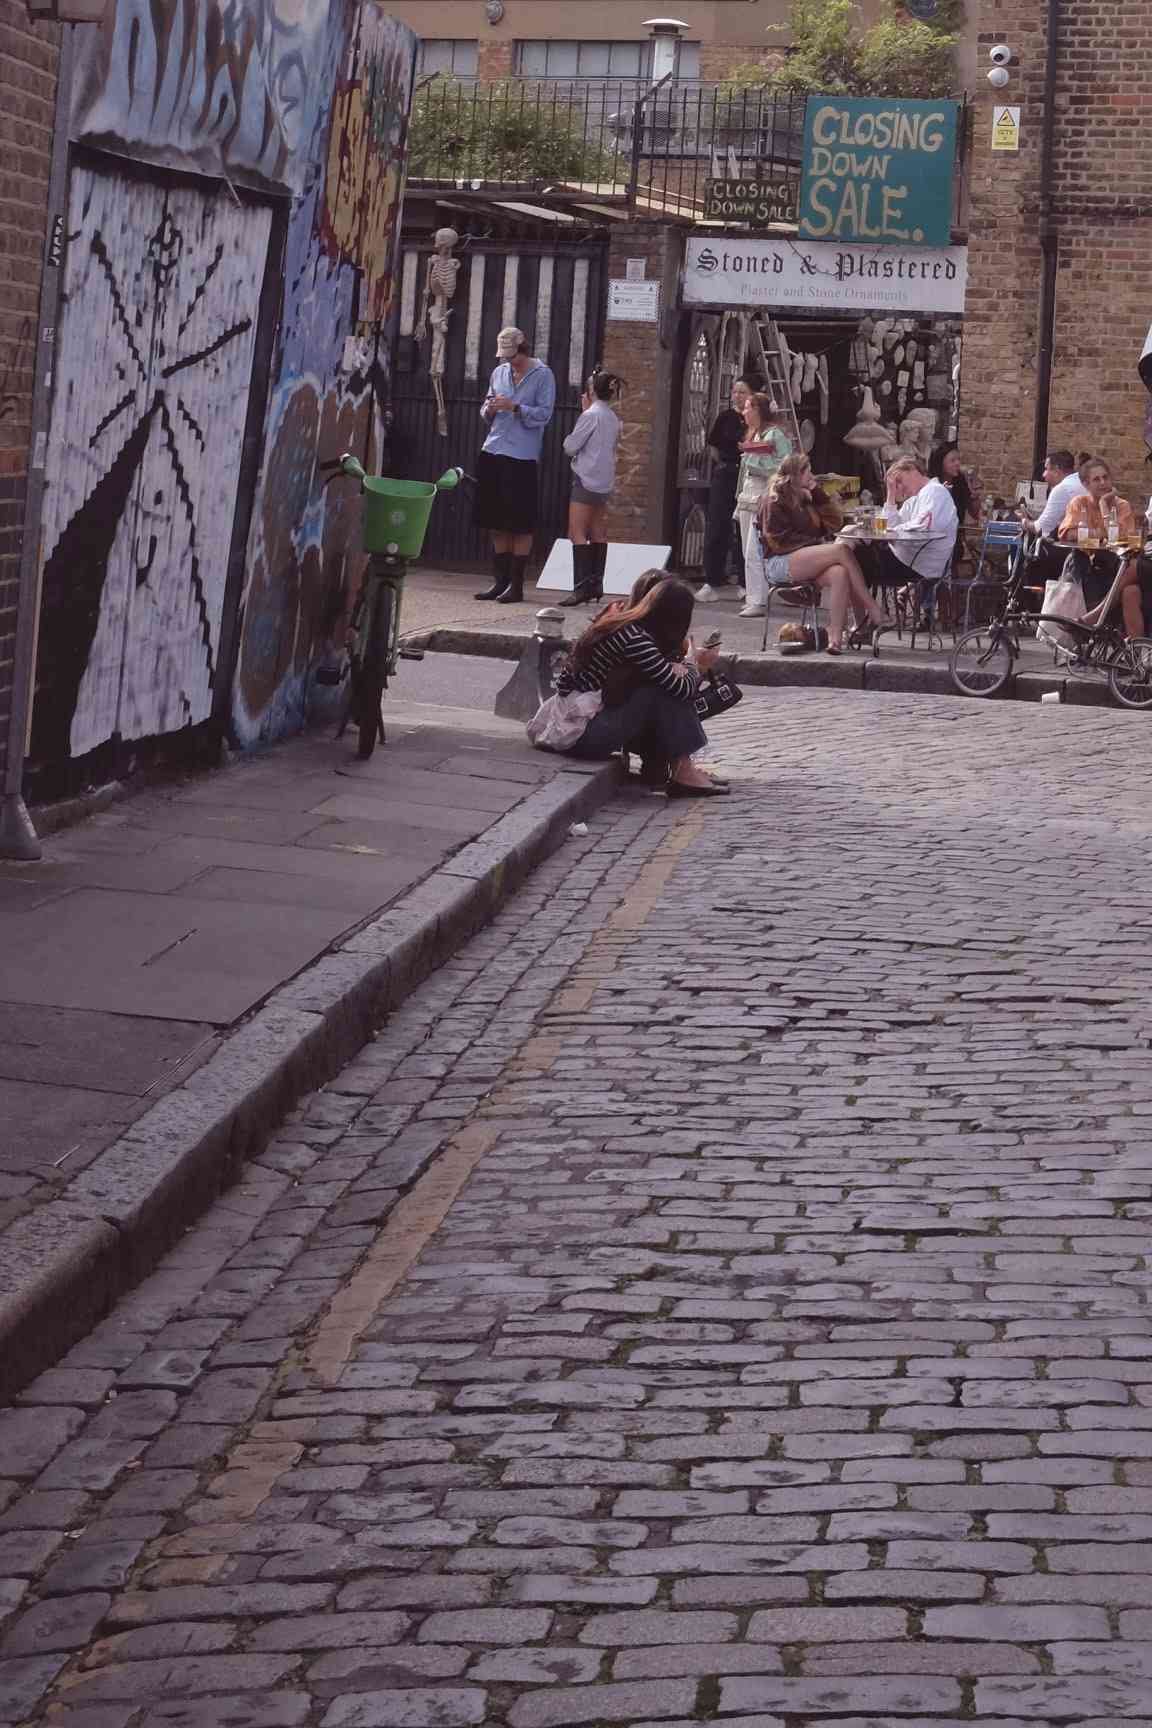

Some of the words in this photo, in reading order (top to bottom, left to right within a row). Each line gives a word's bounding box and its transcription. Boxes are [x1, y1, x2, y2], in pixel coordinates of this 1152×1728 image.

[813, 106, 944, 152] CLOSING
[809, 147, 892, 180] DOWN
[713, 182, 788, 202] CLOSING
[711, 200, 754, 215] DOWN
[756, 202, 795, 220] SALE
[801, 178, 924, 241] SALE.
[696, 247, 784, 273] Stoned
[800, 256, 817, 275] &
[834, 251, 956, 281] Plastered
[740, 284, 778, 297] Plaster
[783, 286, 802, 297] and
[808, 286, 840, 299] Stone
[845, 287, 908, 301] Ornaments
